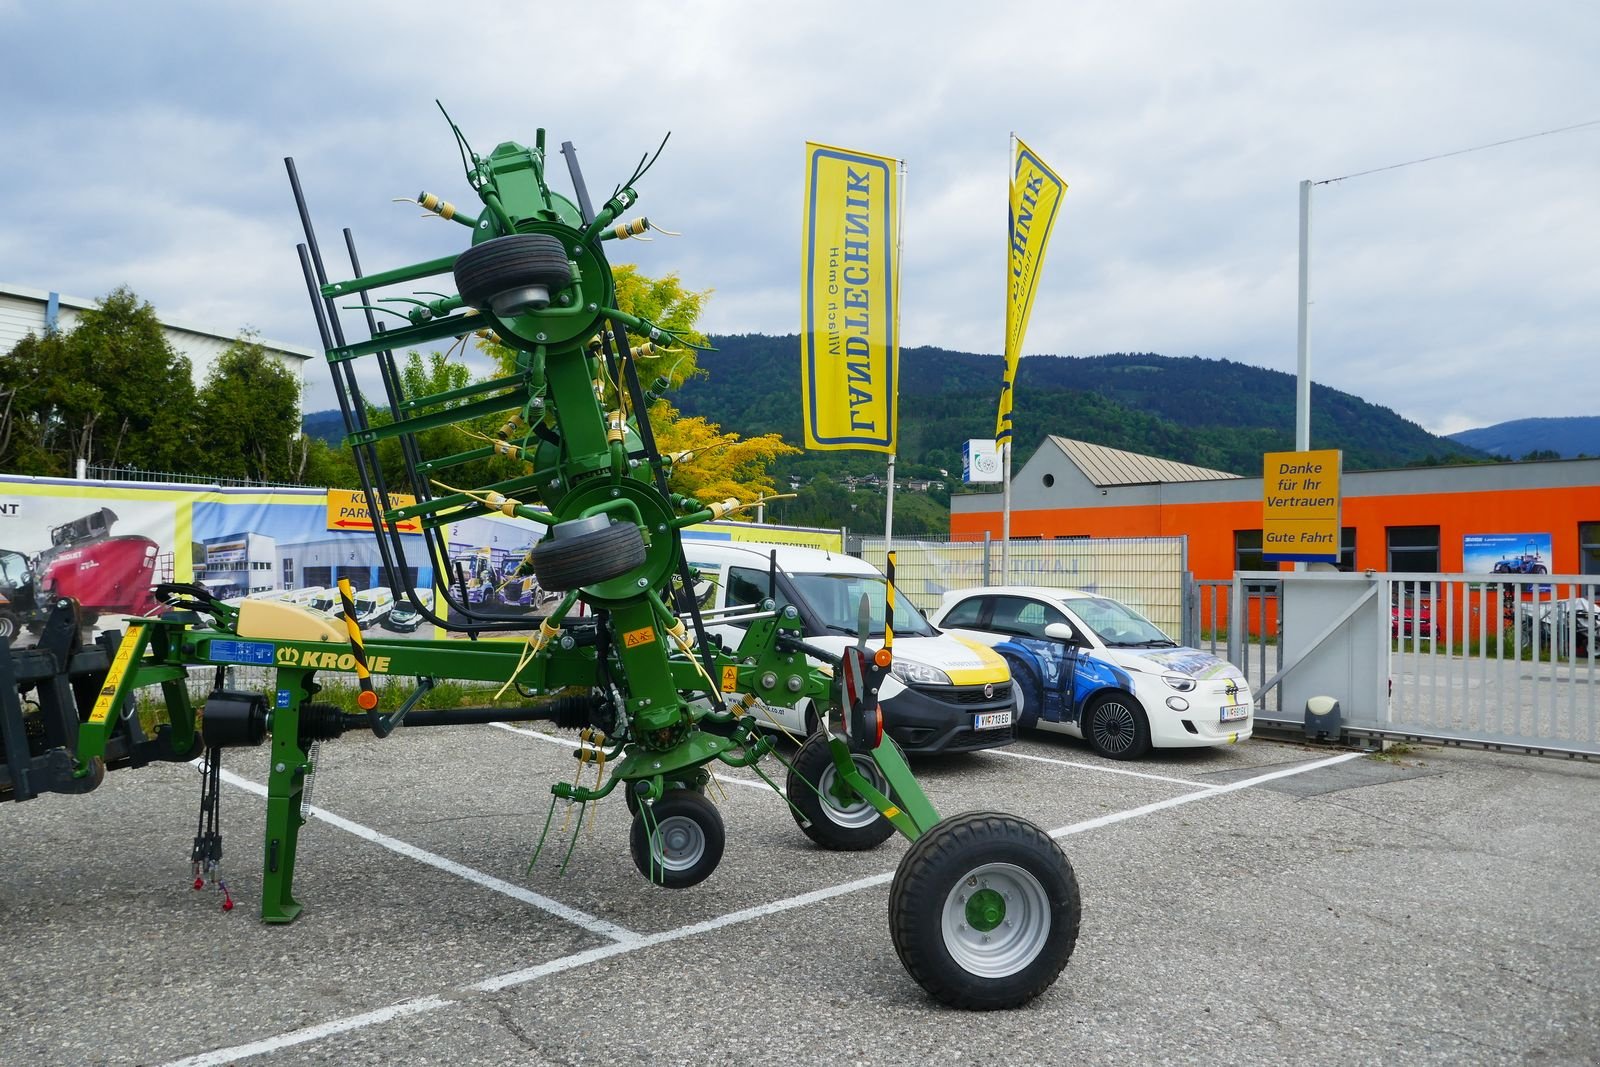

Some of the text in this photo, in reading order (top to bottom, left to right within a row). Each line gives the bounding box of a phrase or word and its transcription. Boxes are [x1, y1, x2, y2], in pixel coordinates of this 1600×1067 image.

[1279, 462, 1322, 475] Danke
[1278, 478, 1322, 491] für Ihr
[1267, 496, 1335, 507] Vertrauen
[1266, 532, 1334, 543] Gute Fahrt
